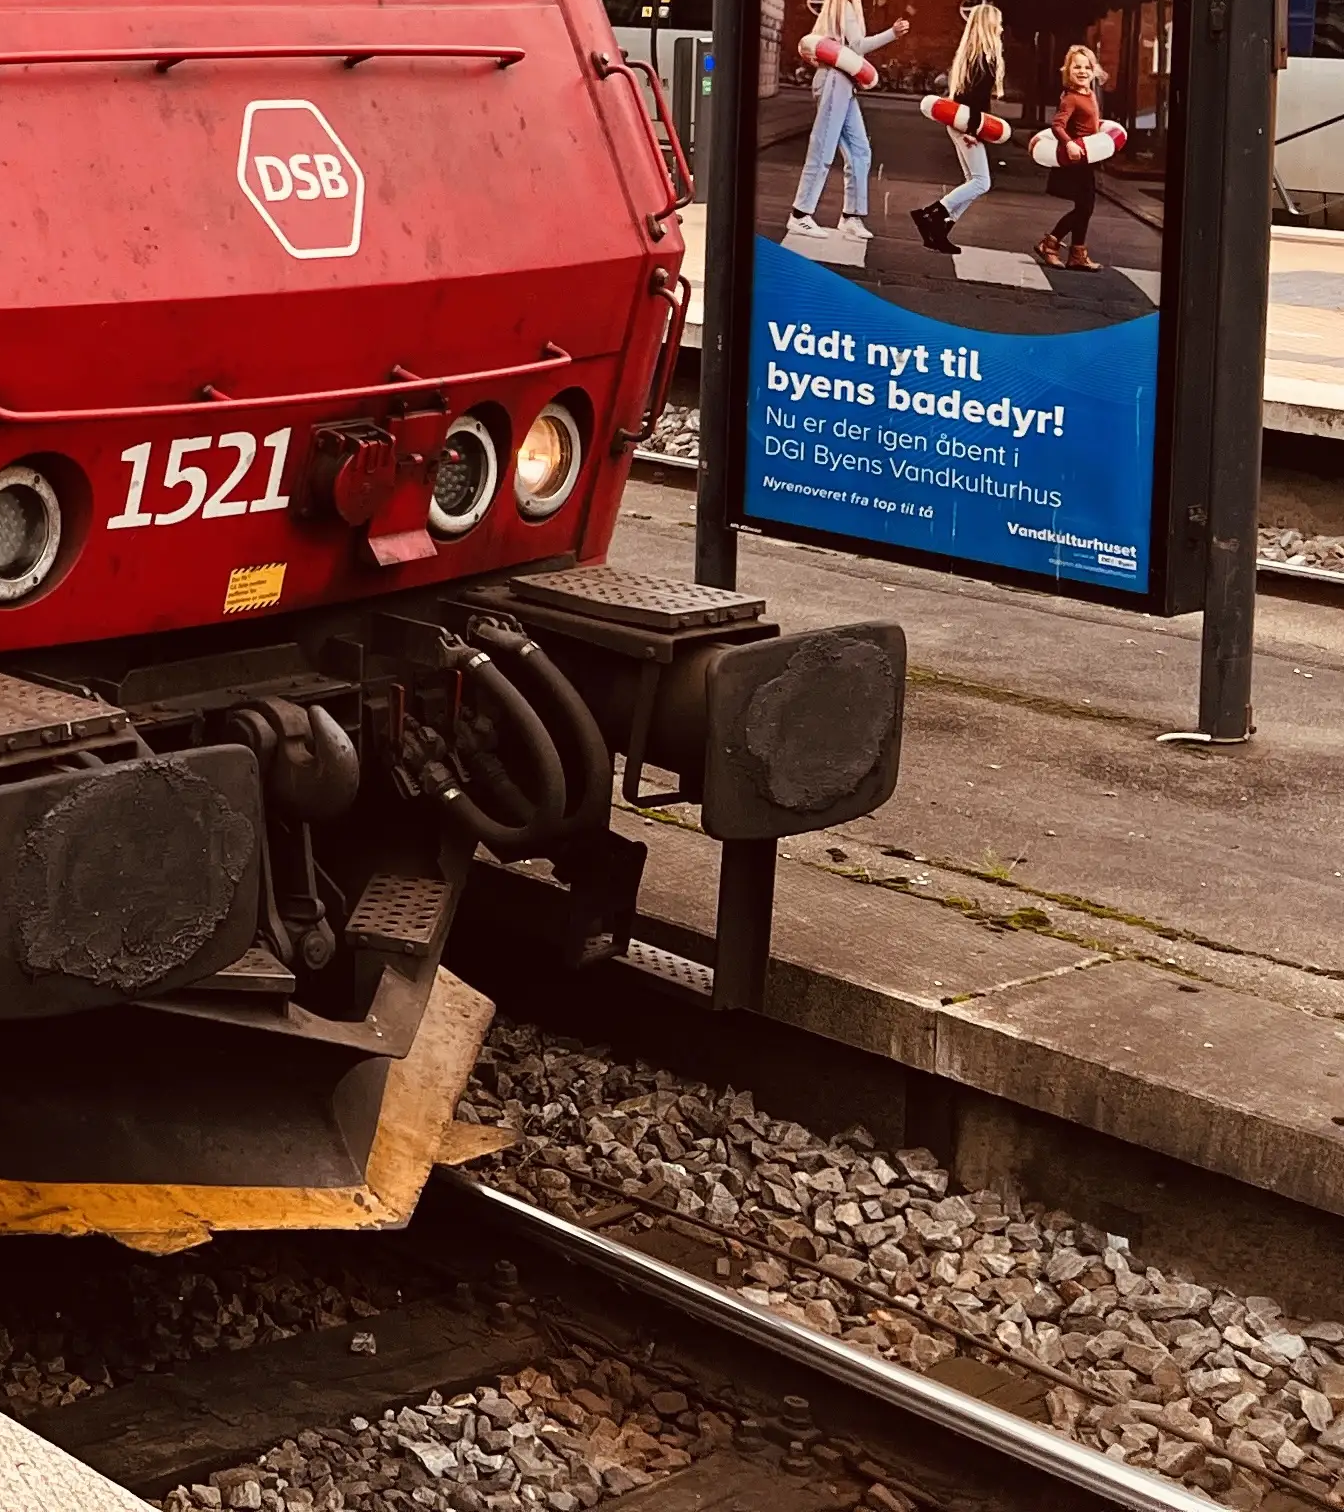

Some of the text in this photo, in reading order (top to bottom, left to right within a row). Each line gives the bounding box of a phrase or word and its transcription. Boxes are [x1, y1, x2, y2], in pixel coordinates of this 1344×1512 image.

[254, 153, 349, 202] DSB
[768, 322, 982, 381] Vådt nyt til
[767, 362, 1065, 438] byens badedyr!
[766, 406, 1019, 468] Nu er der igen åbent i
[107, 427, 292, 530] 1521
[762, 475, 934, 519] Nyrenoveret fra top til tå
[765, 436, 1062, 508] DGI Byens Vandkulturhus
[1007, 521, 1137, 558] Vandkulturhuset
